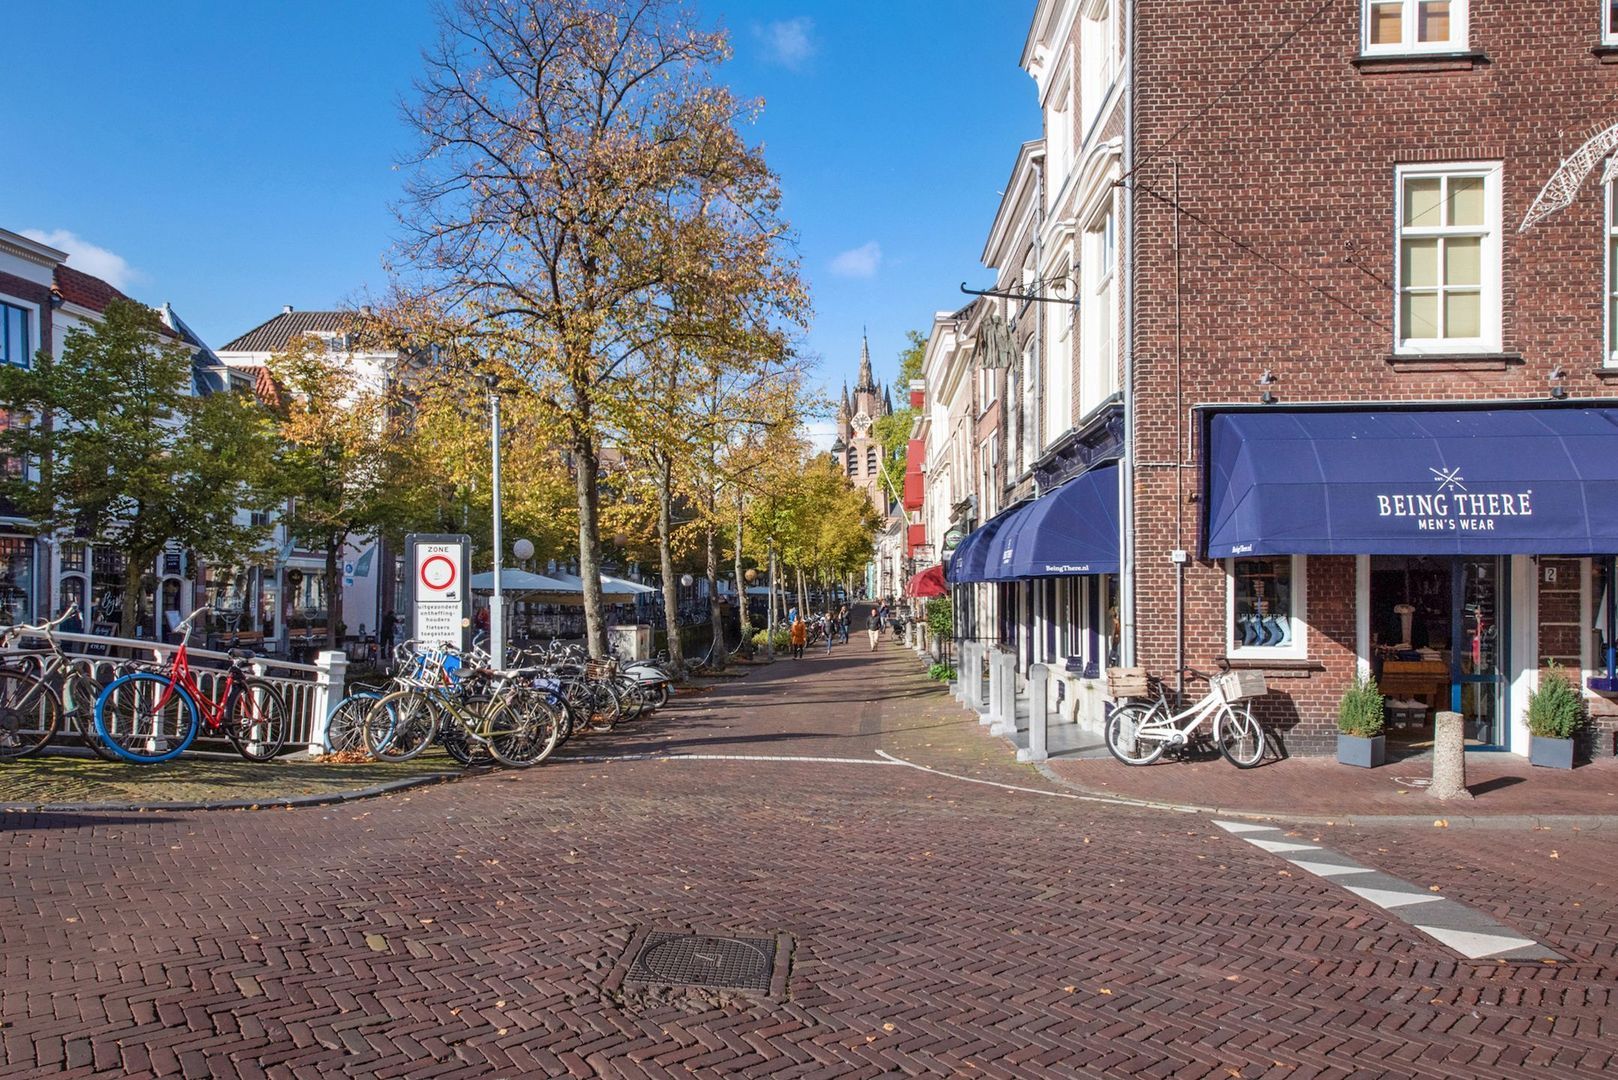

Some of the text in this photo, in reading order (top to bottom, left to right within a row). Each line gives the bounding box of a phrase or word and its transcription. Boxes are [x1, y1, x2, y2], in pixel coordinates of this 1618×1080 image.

[1377, 493, 1532, 516] BEING THERE
[1418, 519, 1495, 530] MEN'S WEAR
[1547, 568, 1555, 581] 2
